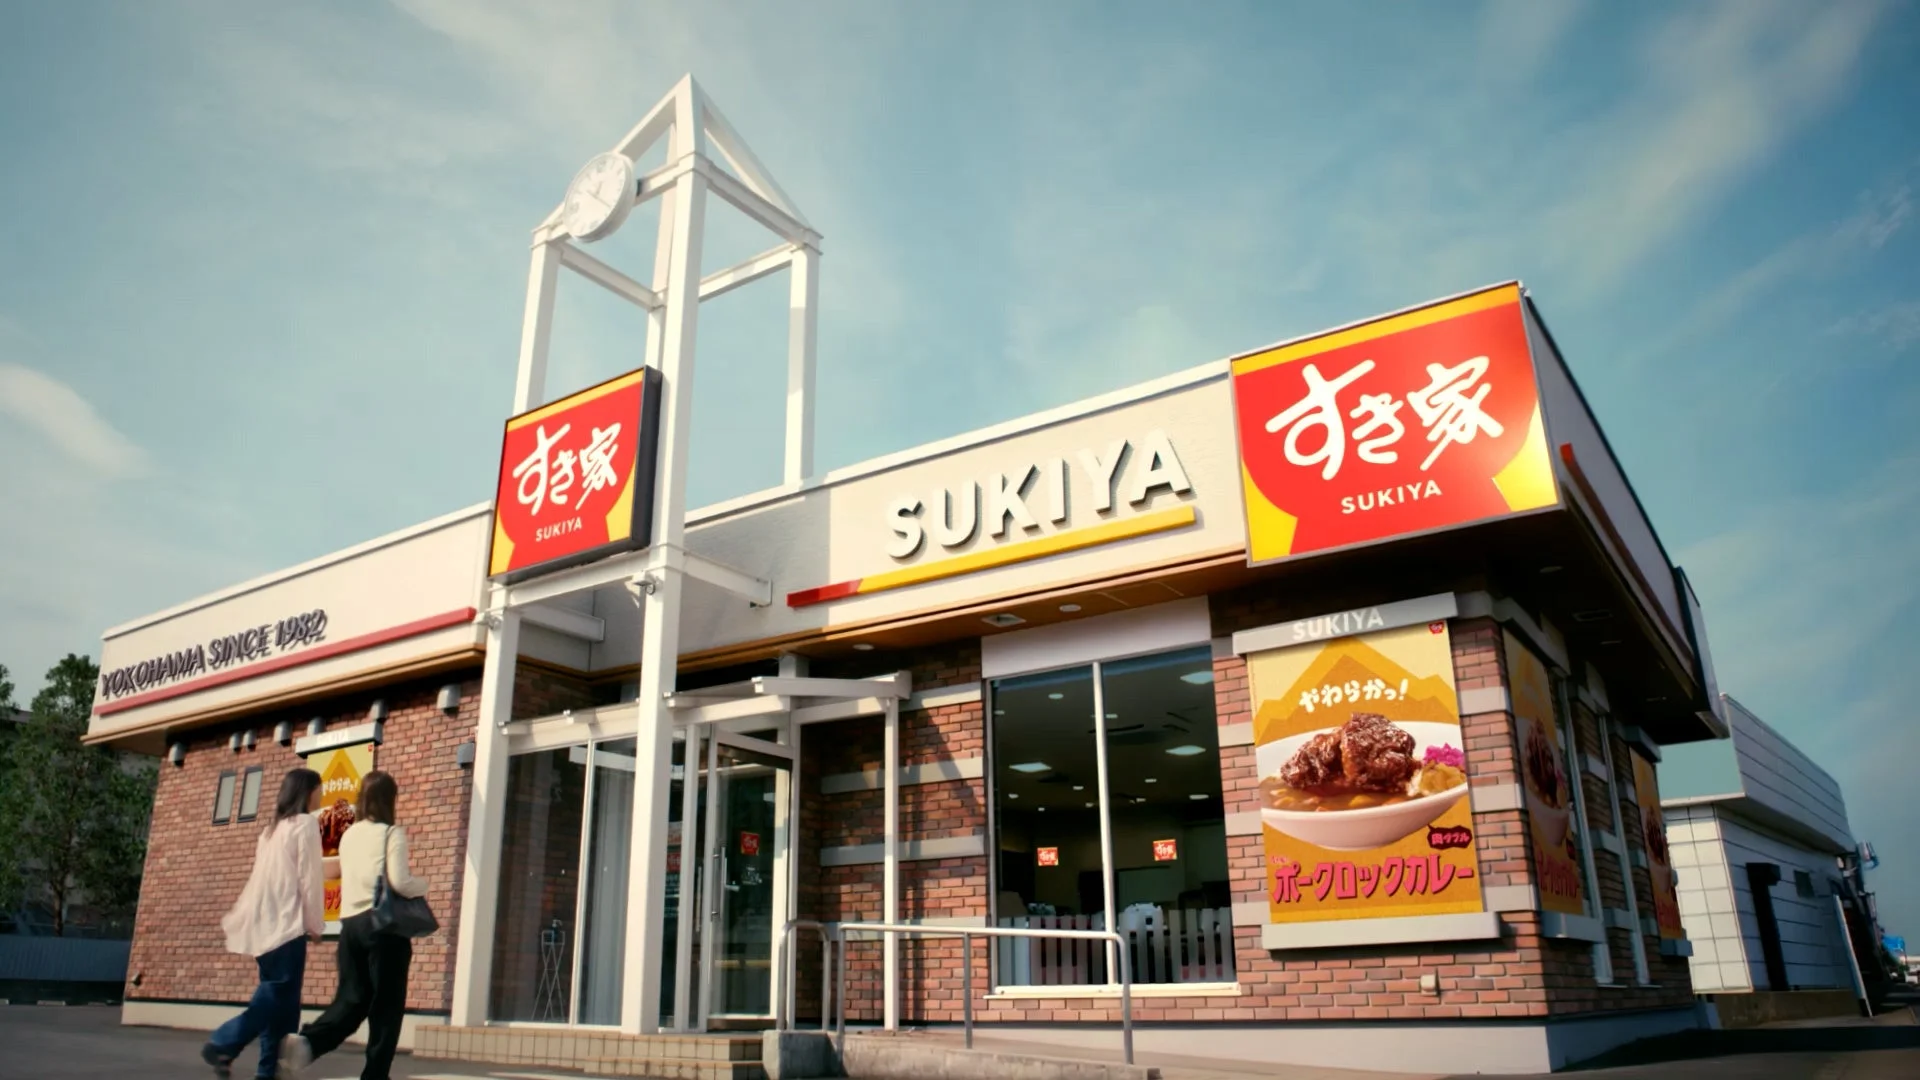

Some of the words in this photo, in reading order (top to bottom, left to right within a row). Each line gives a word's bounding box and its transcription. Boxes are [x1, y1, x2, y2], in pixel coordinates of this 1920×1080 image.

[1265, 356, 1504, 481] すき家
[512, 422, 622, 516] すき家
[885, 428, 1193, 561] SUKIYA
[1341, 479, 1443, 514] SUKIYA
[535, 517, 583, 542] SUKIYA
[101, 644, 206, 698] YOKOHAMA
[208, 623, 273, 667] SINCE
[274, 608, 328, 649] 1982
[1292, 607, 1384, 641] SUKIYA
[1272, 853, 1475, 904] ポークロックカレー
